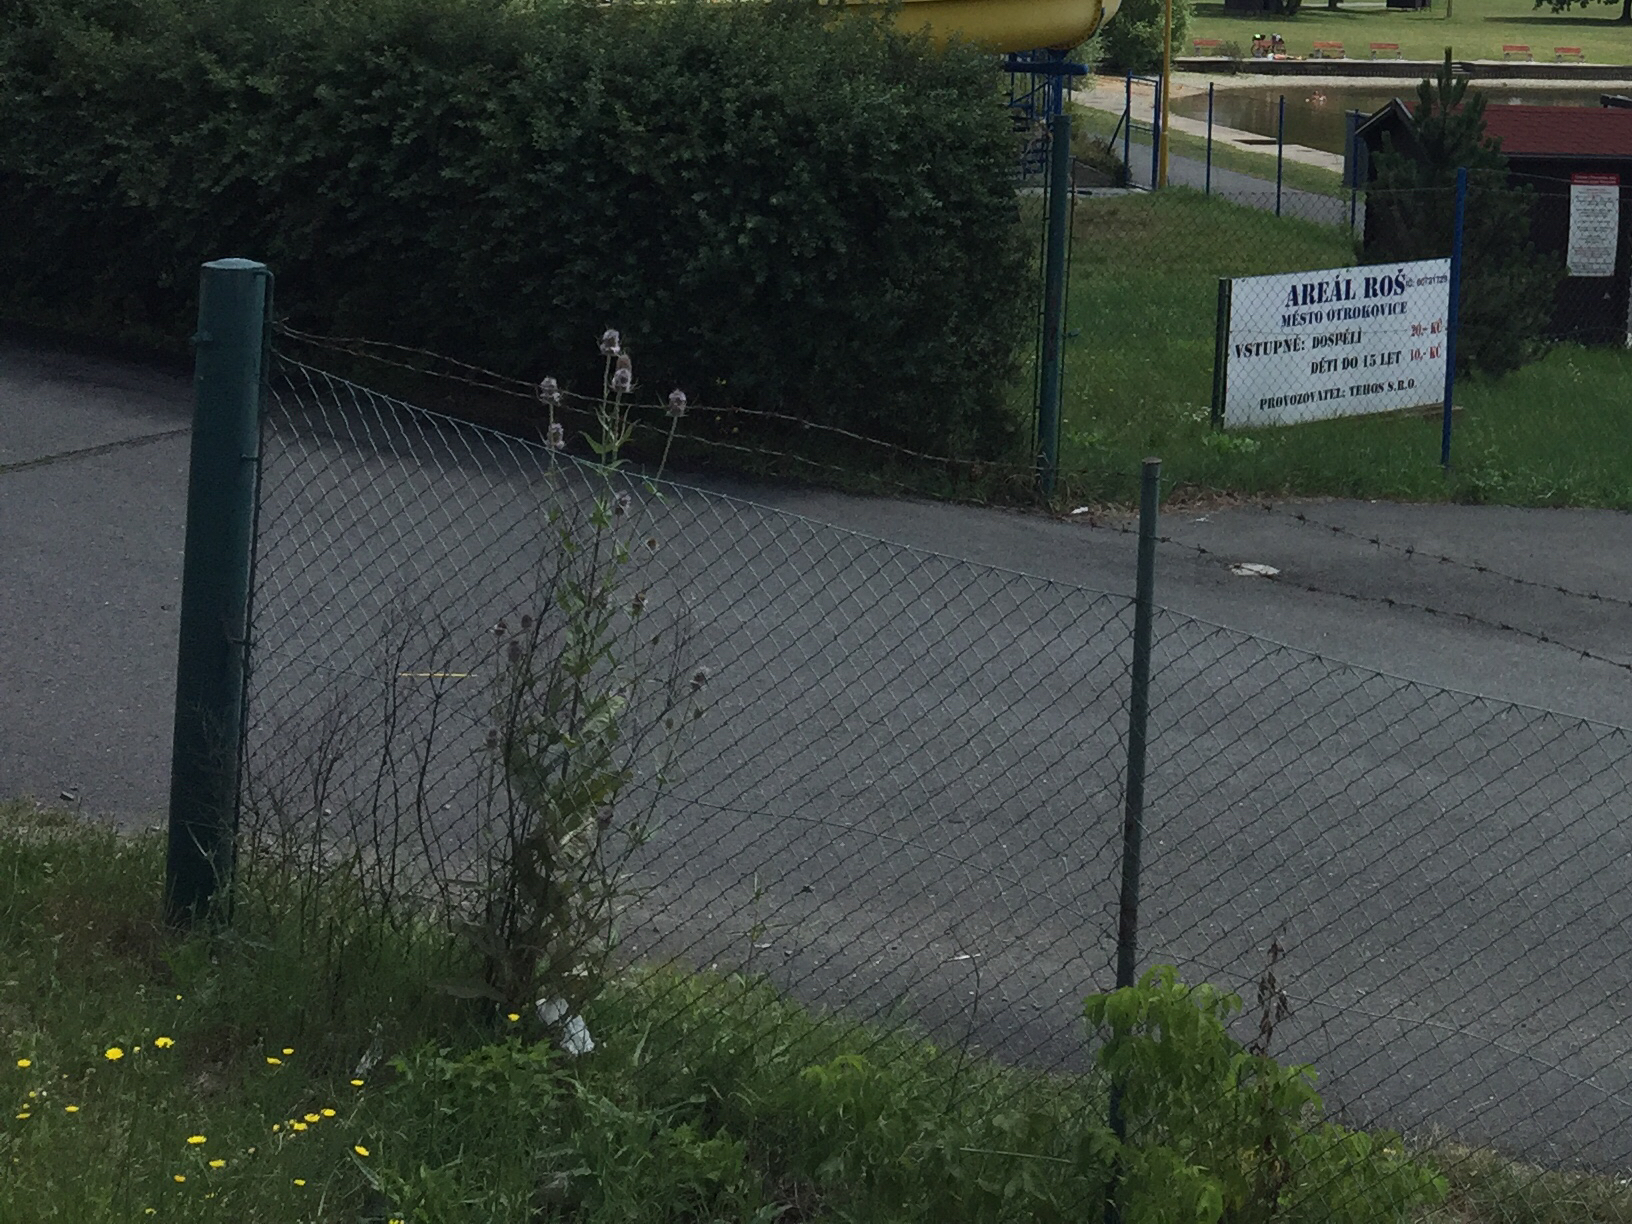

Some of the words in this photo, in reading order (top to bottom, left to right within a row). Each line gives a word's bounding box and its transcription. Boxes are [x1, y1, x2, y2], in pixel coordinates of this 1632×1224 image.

[1284, 274, 1357, 308] AREÁL
[1363, 268, 1407, 299] ROŠ
[1326, 301, 1409, 323] OTROKOVICE
[1234, 335, 1306, 359] VSTUPNÉ:
[1342, 355, 1359, 370] DO
[1363, 356, 1376, 368] 15
[1380, 350, 1403, 366] LET
[1259, 387, 1346, 412] PROVOZOVATEL:
[1349, 381, 1385, 398] TEHOS
[1387, 378, 1418, 394] S.R.O.
